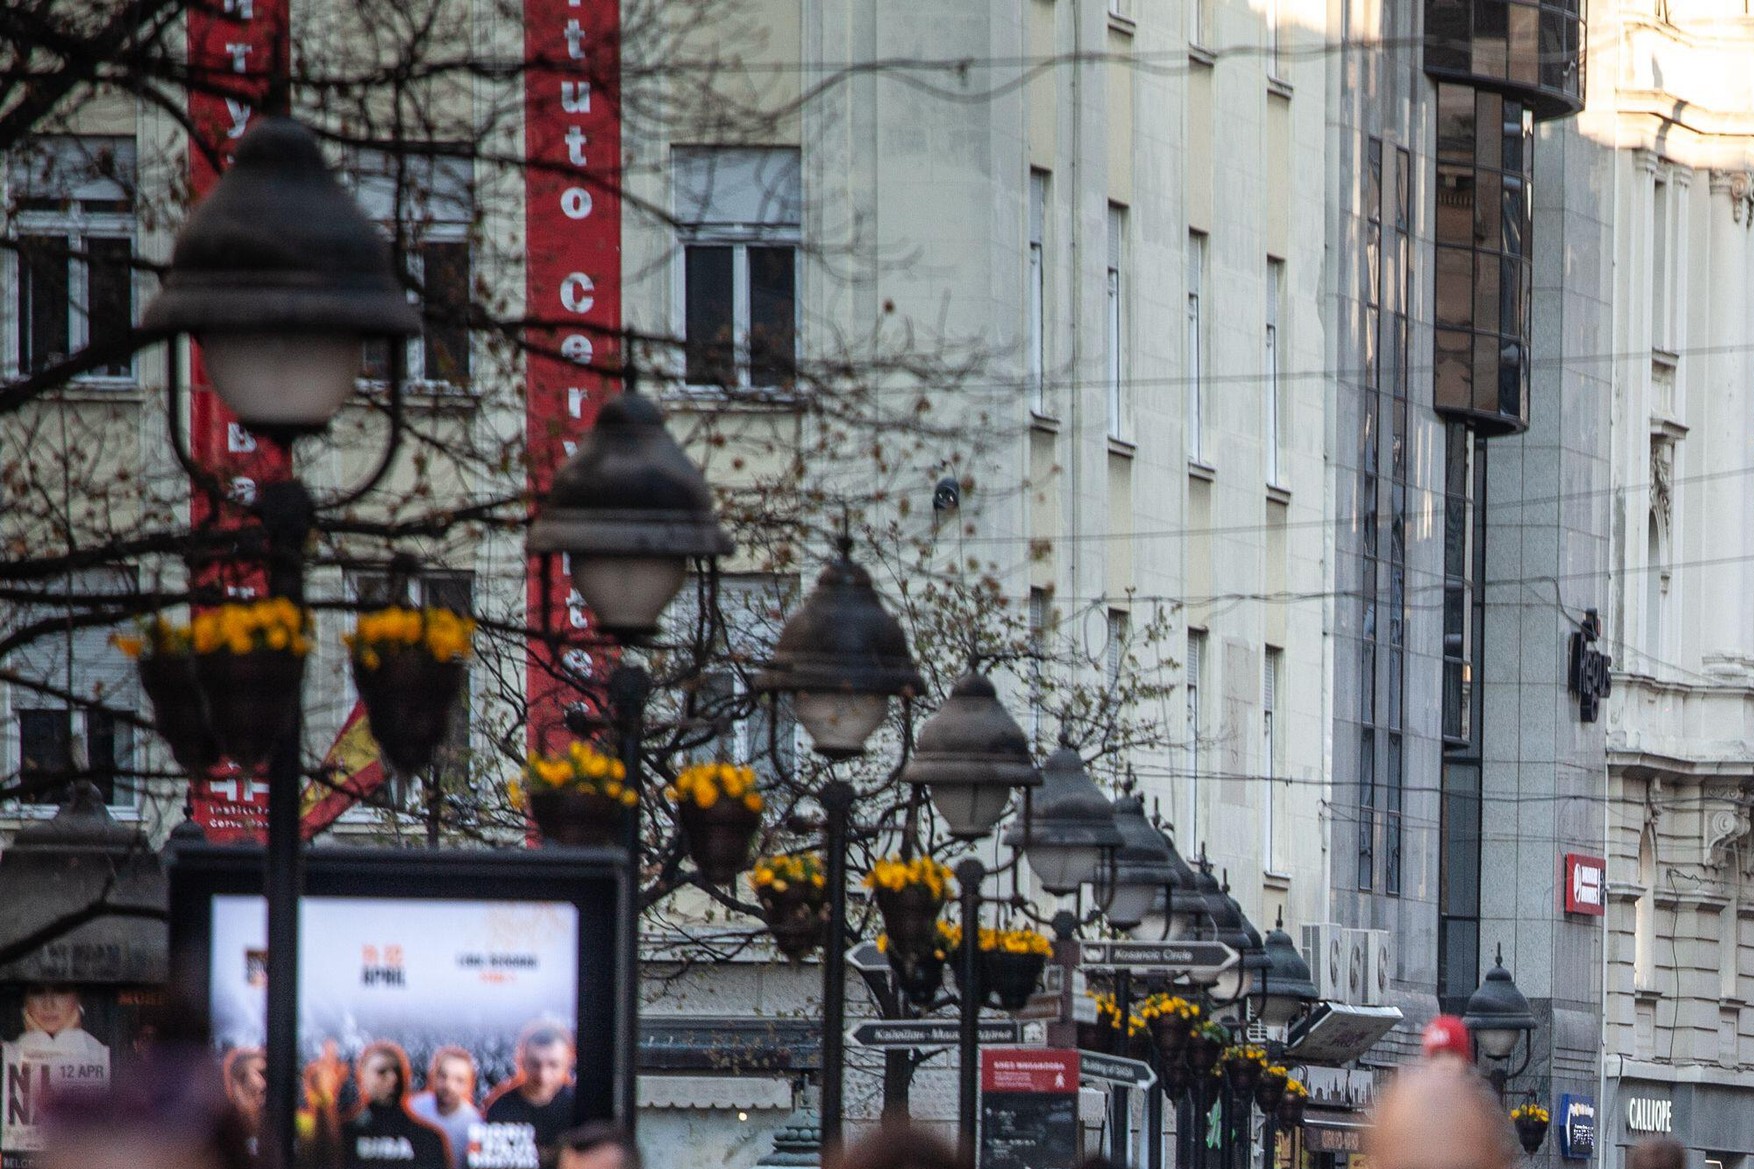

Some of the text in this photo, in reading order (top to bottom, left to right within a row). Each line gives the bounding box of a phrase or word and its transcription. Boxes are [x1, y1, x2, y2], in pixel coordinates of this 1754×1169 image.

[59, 1064, 105, 1080] 12 APR
[1629, 1097, 1672, 1133] CALLIOPE
